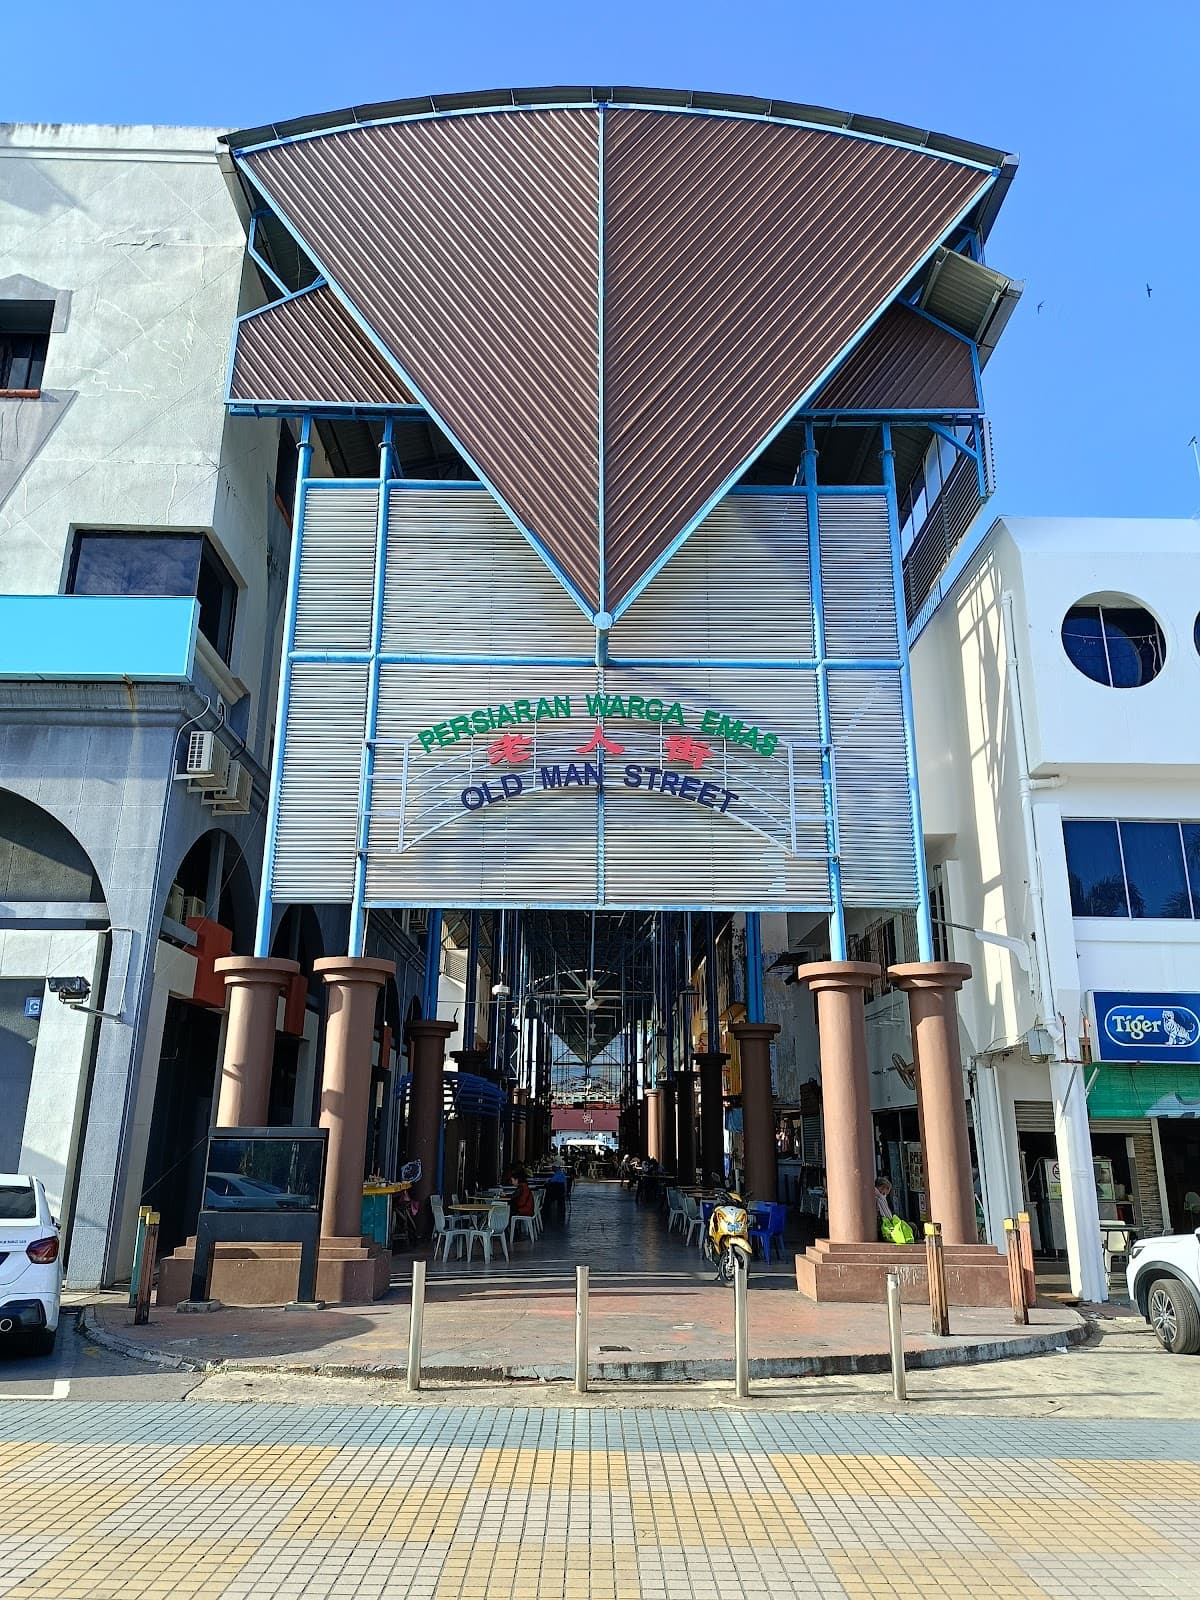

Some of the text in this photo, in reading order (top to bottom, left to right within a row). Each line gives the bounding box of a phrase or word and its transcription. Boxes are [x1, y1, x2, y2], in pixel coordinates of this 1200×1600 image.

[417, 694, 779, 757] PERSIARAN WARGA EMAS
[487, 726, 715, 770] 老人街
[461, 762, 740, 813] OLD MAN STREET
[1112, 1015, 1161, 1040] Tiger
